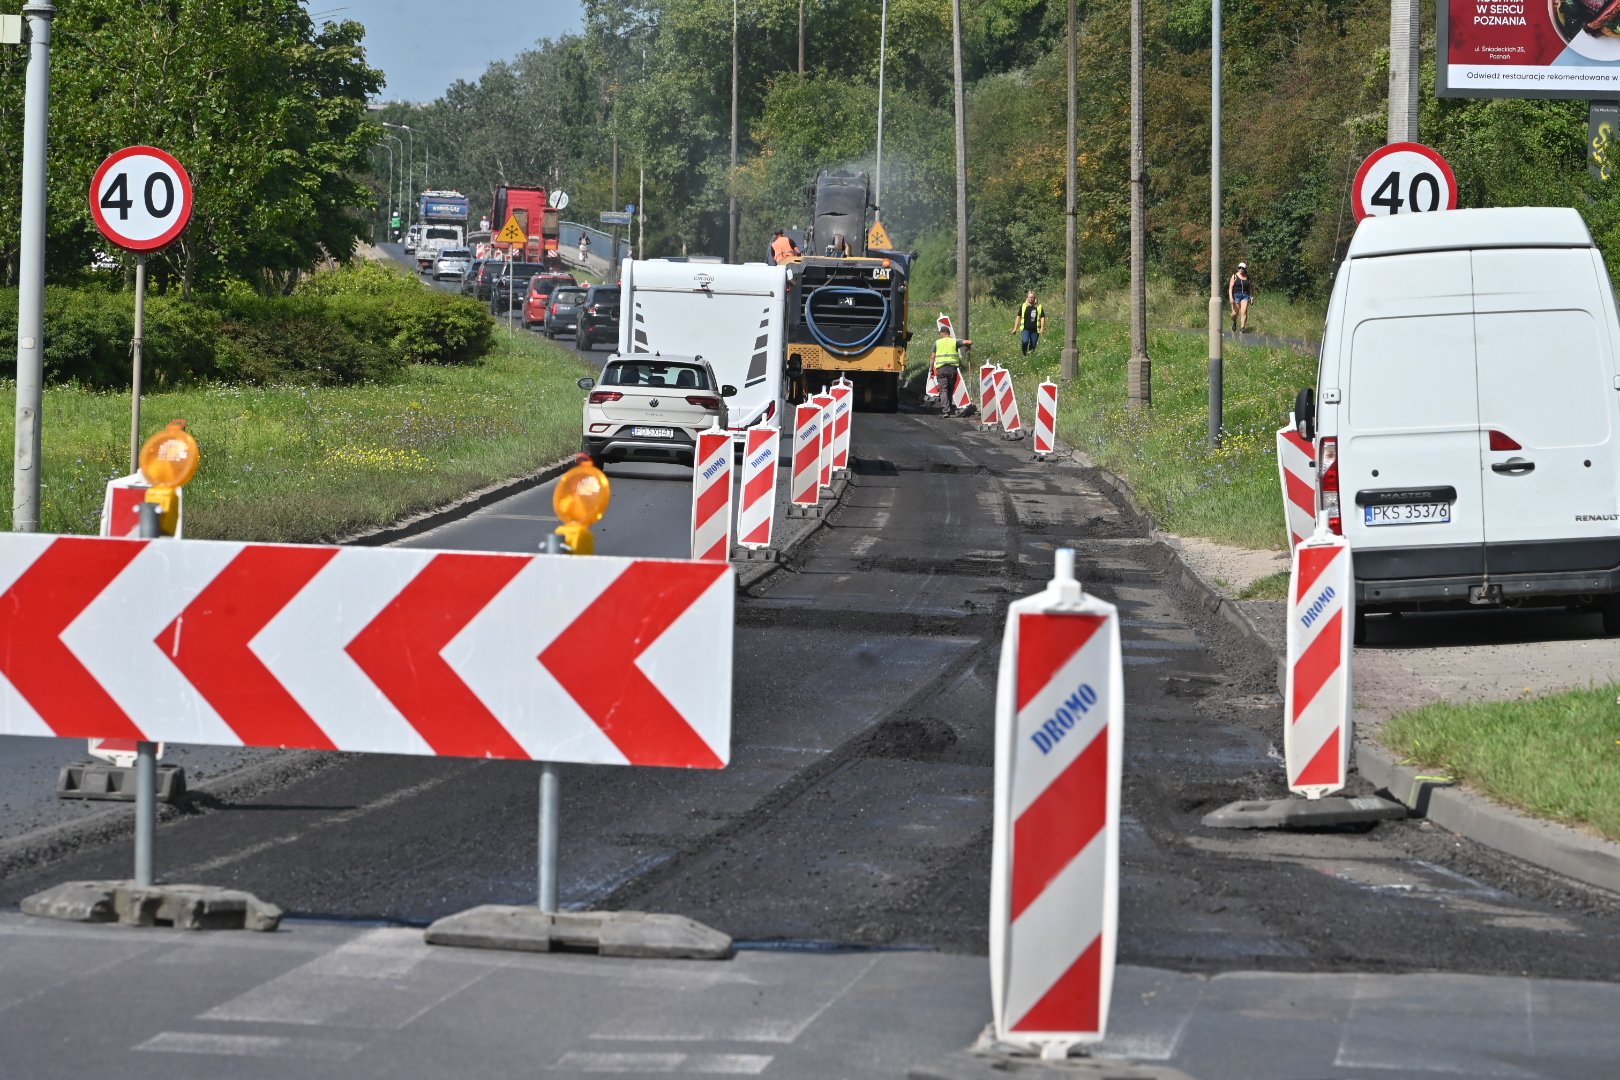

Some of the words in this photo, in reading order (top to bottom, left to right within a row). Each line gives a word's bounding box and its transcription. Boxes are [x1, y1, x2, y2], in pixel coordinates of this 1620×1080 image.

[1476, 5, 1487, 13] W
[1490, 5, 1524, 14] SERCU
[1474, 16, 1526, 25] POZNANIA
[1502, 73, 1546, 82] restauracje
[1547, 73, 1610, 81] rekomendowane
[100, 171, 175, 221] 40
[1371, 171, 1440, 216] 40
[872, 268, 891, 280] CAT
[750, 448, 772, 469] DROMO
[702, 457, 726, 480] DROMO
[1380, 492, 1432, 500] MASTER
[1373, 505, 1400, 521] PKS
[1405, 503, 1447, 519] 35376
[1575, 514, 1619, 522] RENAULT
[1300, 586, 1336, 629] DROMO
[1030, 682, 1098, 756] DROMO
